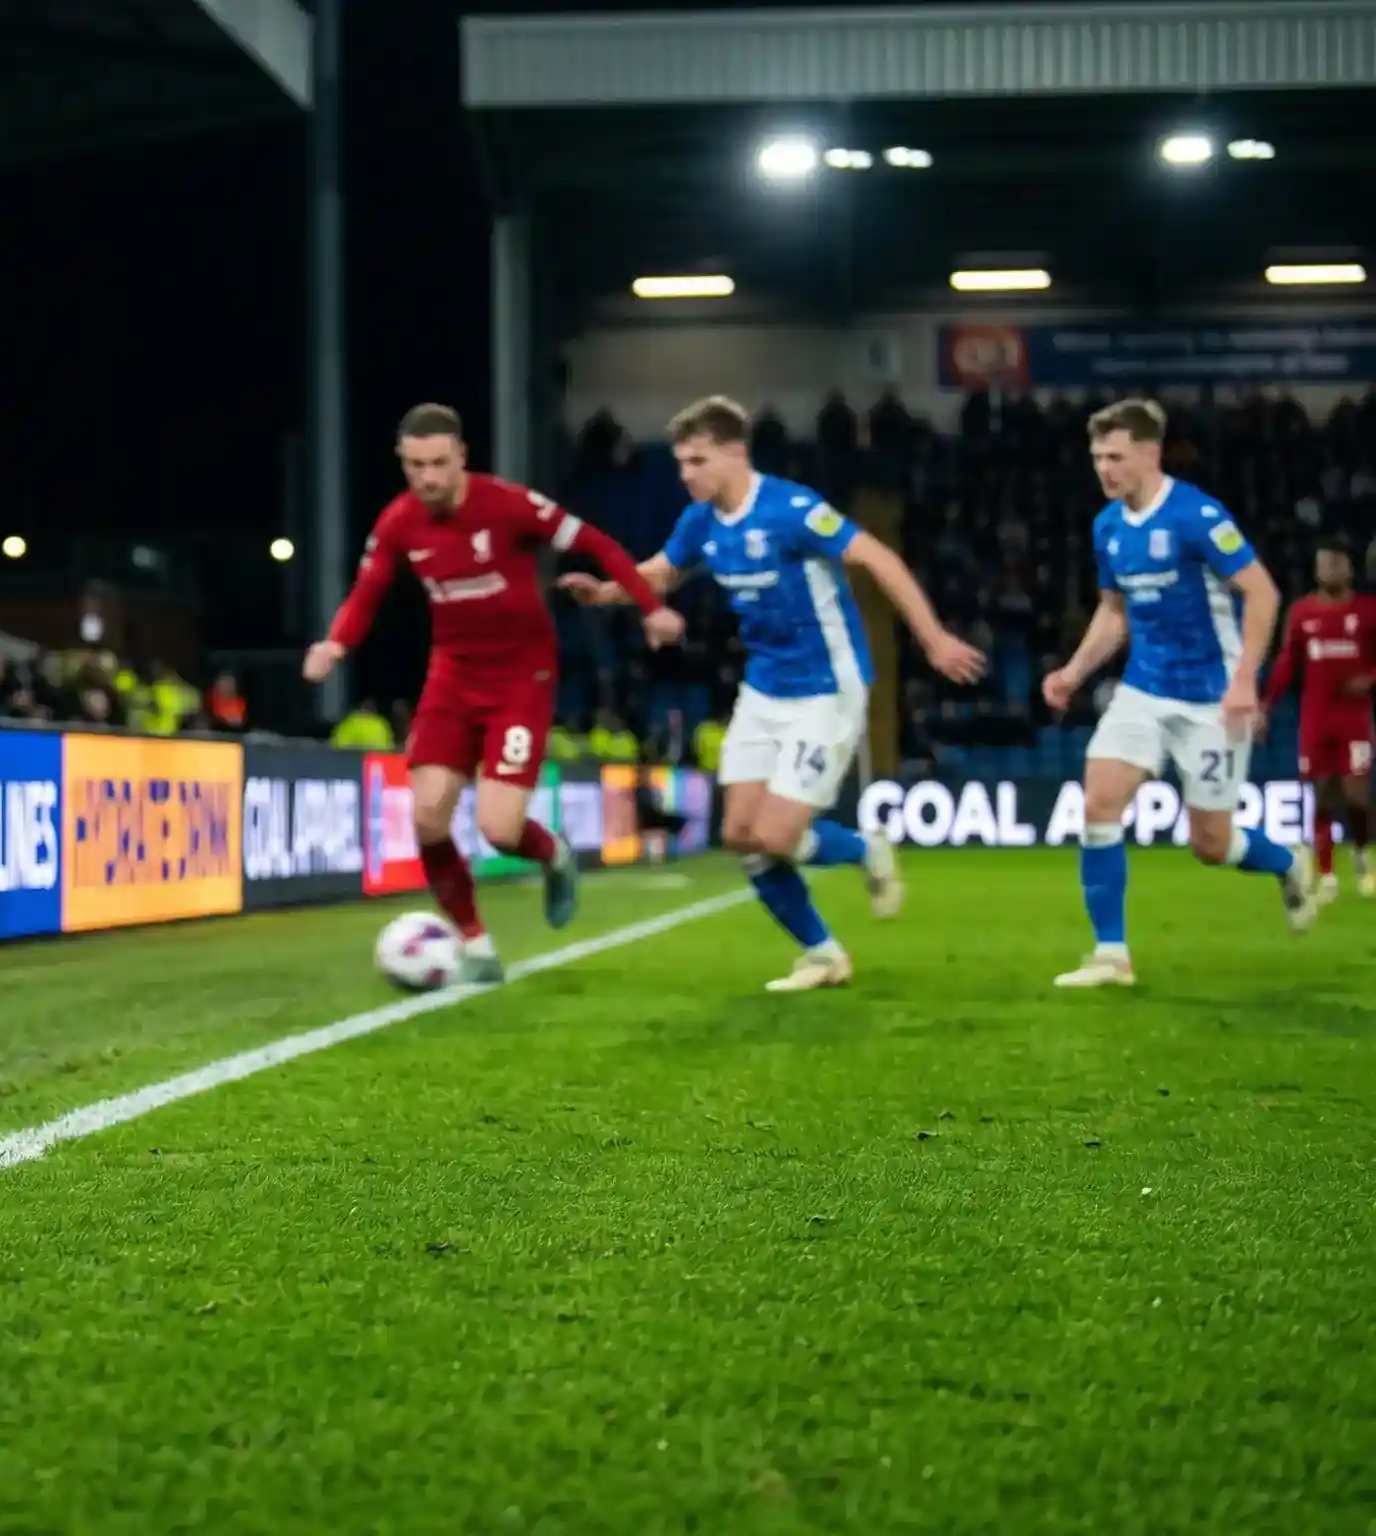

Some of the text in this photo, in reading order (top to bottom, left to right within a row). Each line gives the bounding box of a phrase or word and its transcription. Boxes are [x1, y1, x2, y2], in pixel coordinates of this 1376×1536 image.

[502, 725, 532, 764] 8
[793, 739, 828, 779] 14
[1200, 750, 1235, 782] 21
[857, 779, 1036, 847] GOAL
